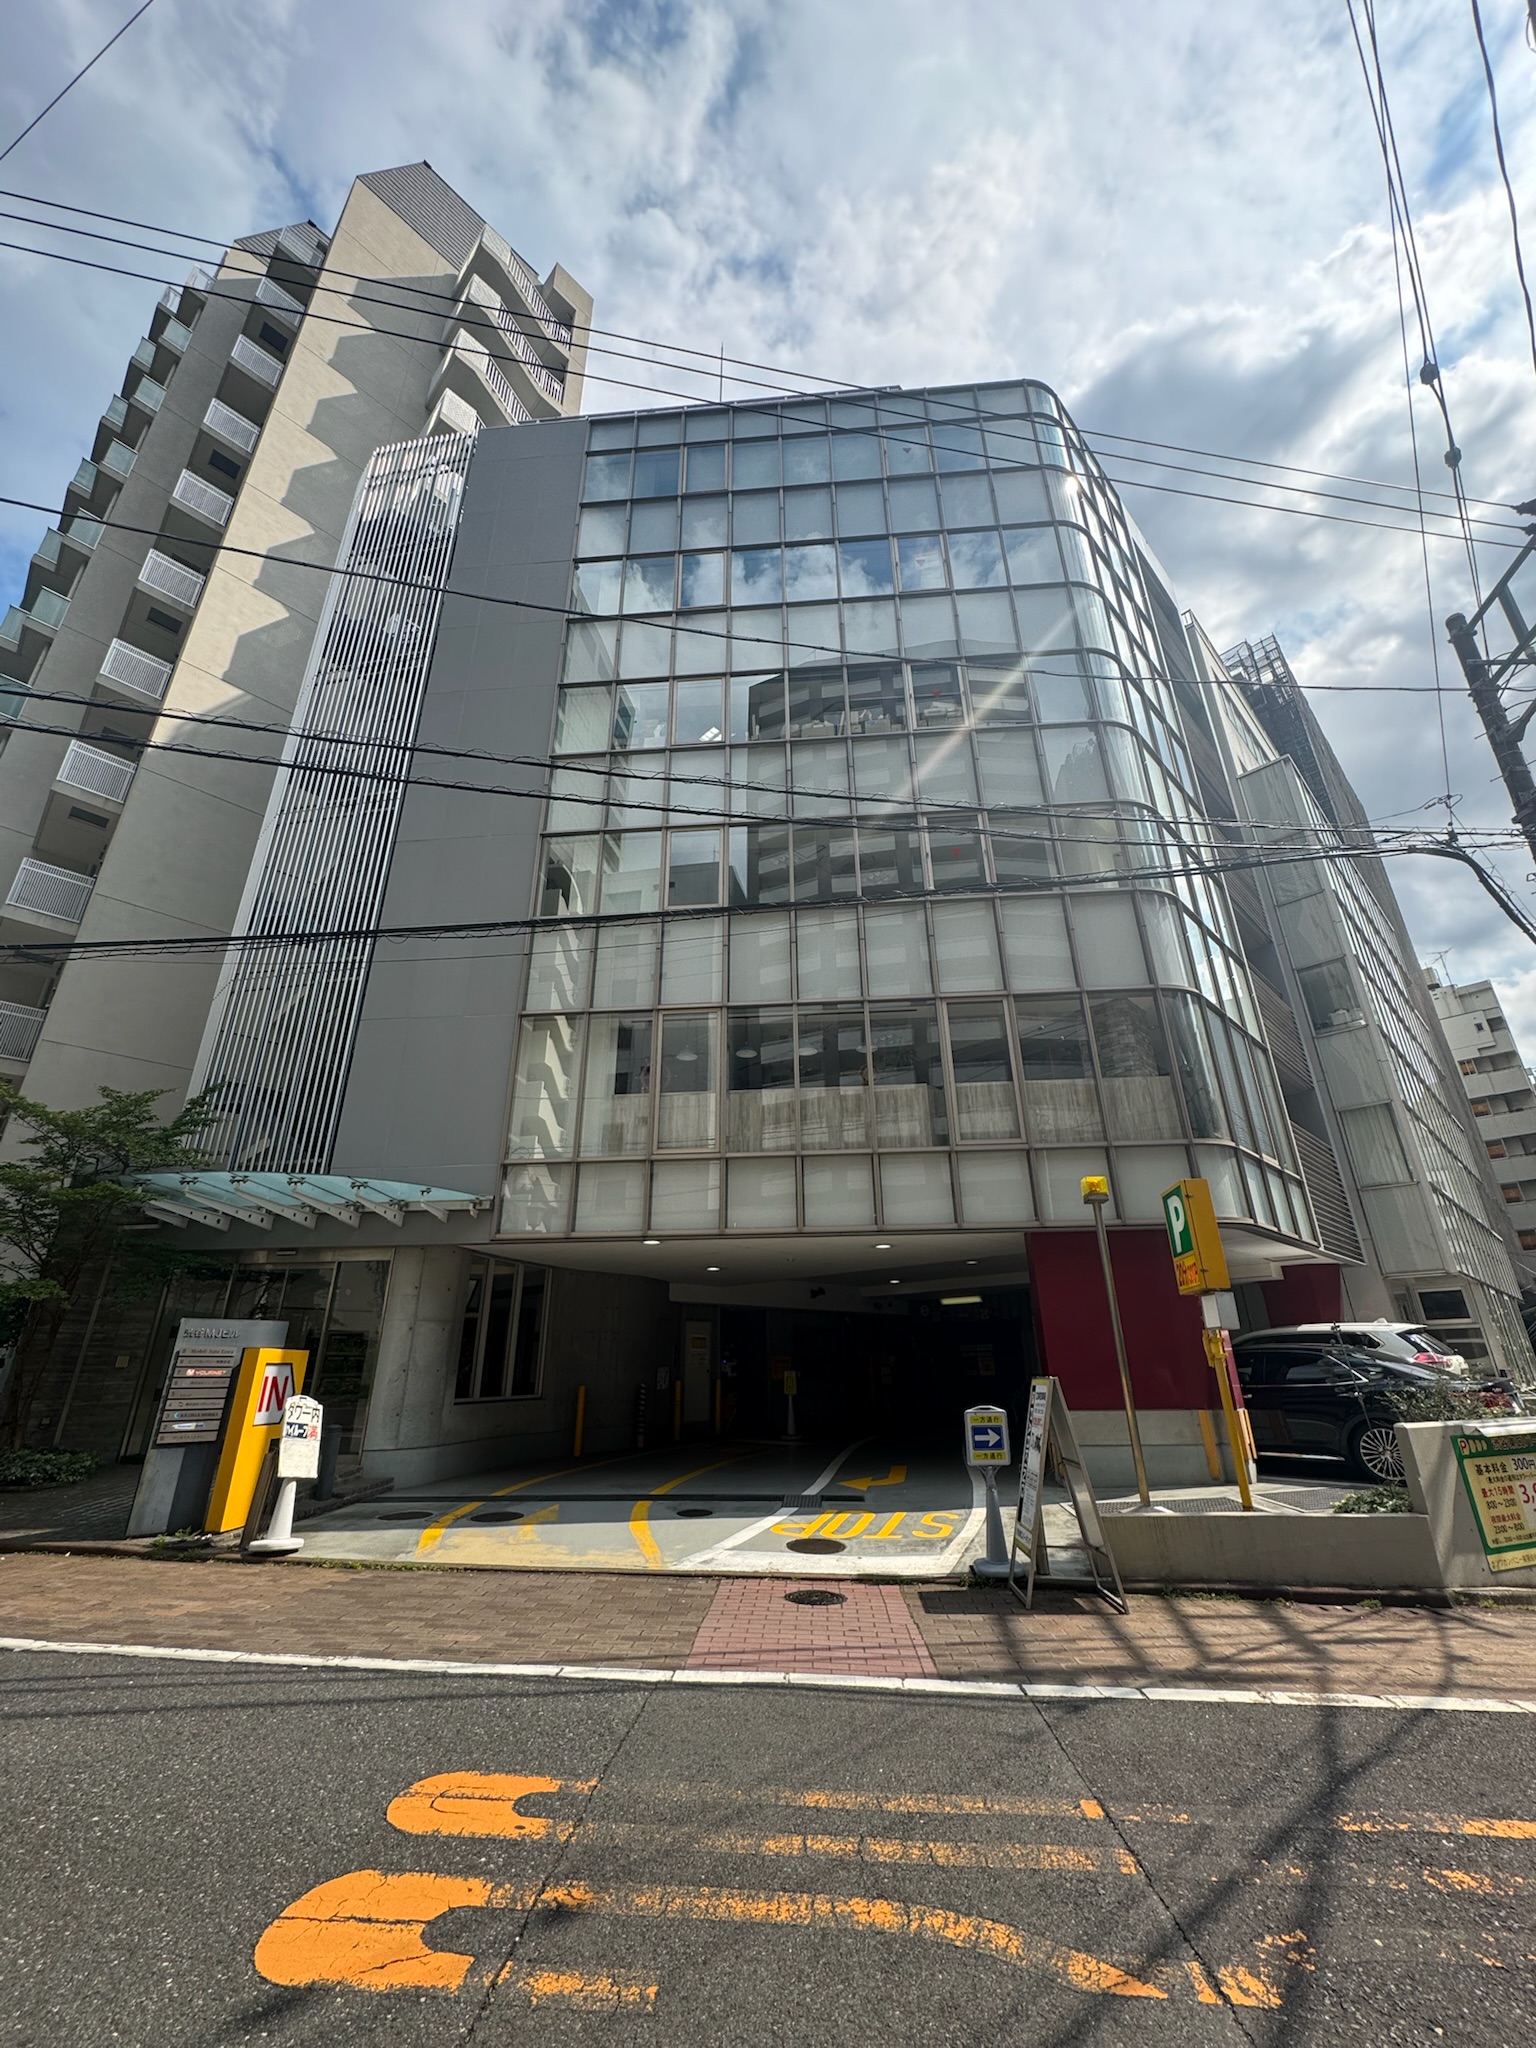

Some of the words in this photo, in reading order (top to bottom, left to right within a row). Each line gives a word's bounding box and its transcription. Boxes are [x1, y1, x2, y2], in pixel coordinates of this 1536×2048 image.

[1167, 1195, 1185, 1254] P
[258, 1376, 289, 1413] IN
[288, 1402, 320, 1423] タワー内
[1475, 1462, 1508, 1475] 基本料金
[769, 1510, 960, 1539] STOP
